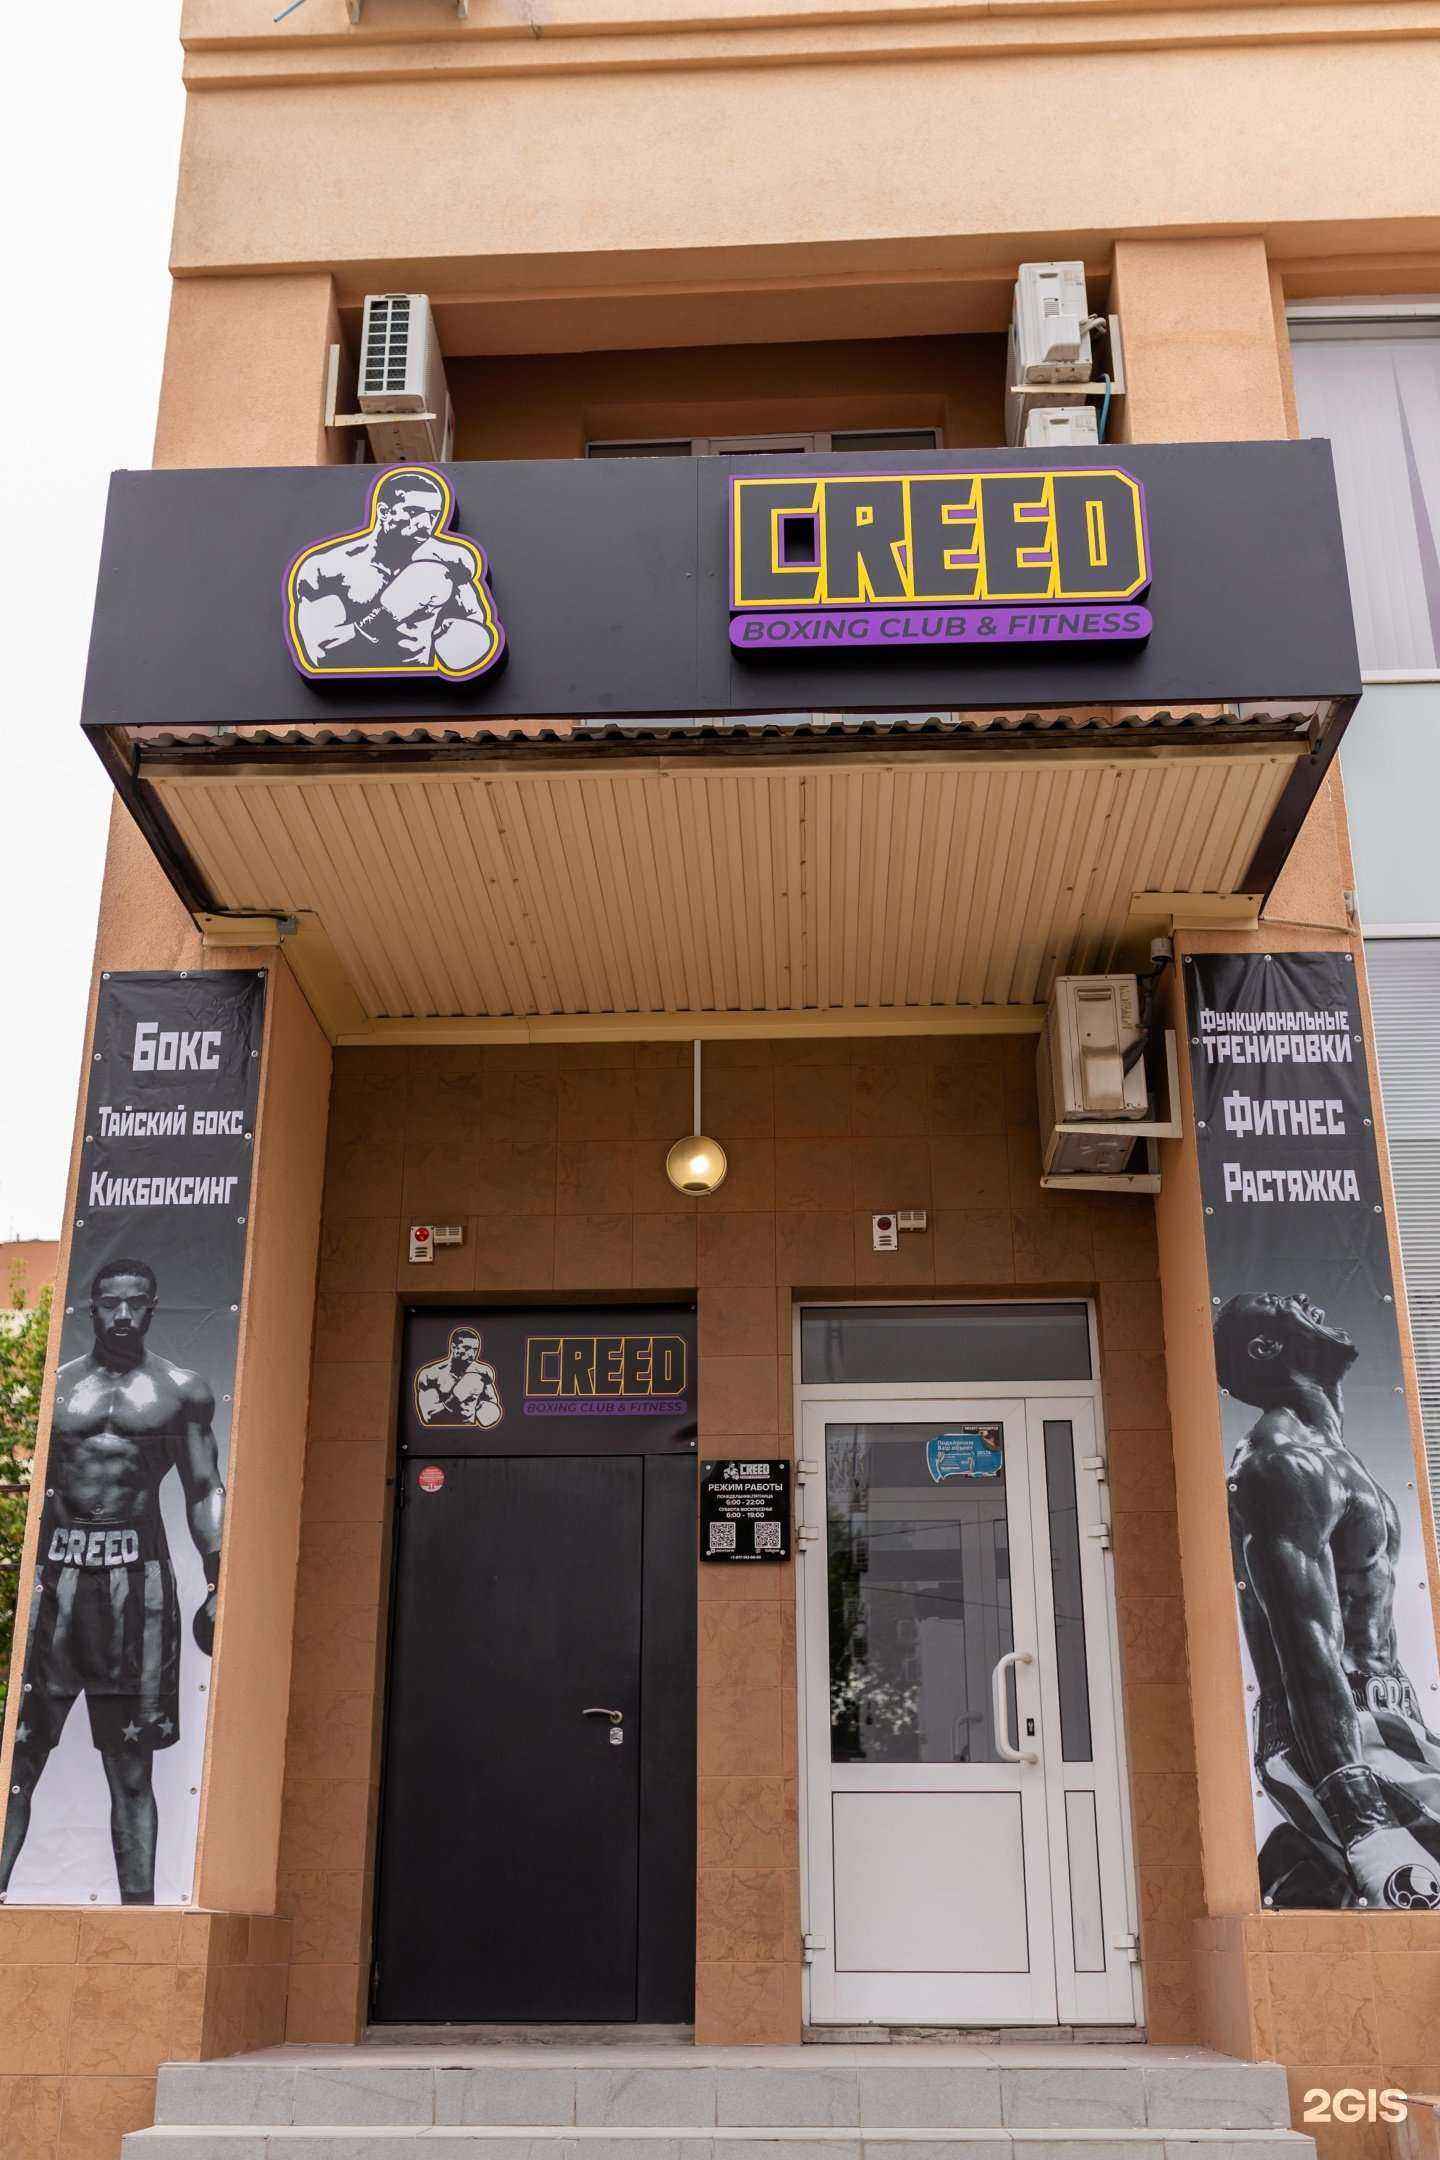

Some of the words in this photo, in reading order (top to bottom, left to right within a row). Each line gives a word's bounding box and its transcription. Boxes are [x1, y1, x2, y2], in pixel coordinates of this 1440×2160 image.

[734, 470, 1147, 607] CREED
[742, 617, 869, 641] BOXING
[880, 615, 966, 638] CLUB
[976, 614, 998, 636] &
[1008, 611, 1142, 635] FITNESS
[525, 1336, 687, 1397] CREED
[526, 1402, 577, 1414] BOXING
[580, 1402, 615, 1413] CLUB
[629, 1401, 683, 1413] FITNESS
[739, 1463, 770, 1475] CREED
[708, 1483, 743, 1492] РЕЖИМ
[744, 1483, 783, 1491] РАБОТЫ
[47, 1527, 140, 1567] CREED
